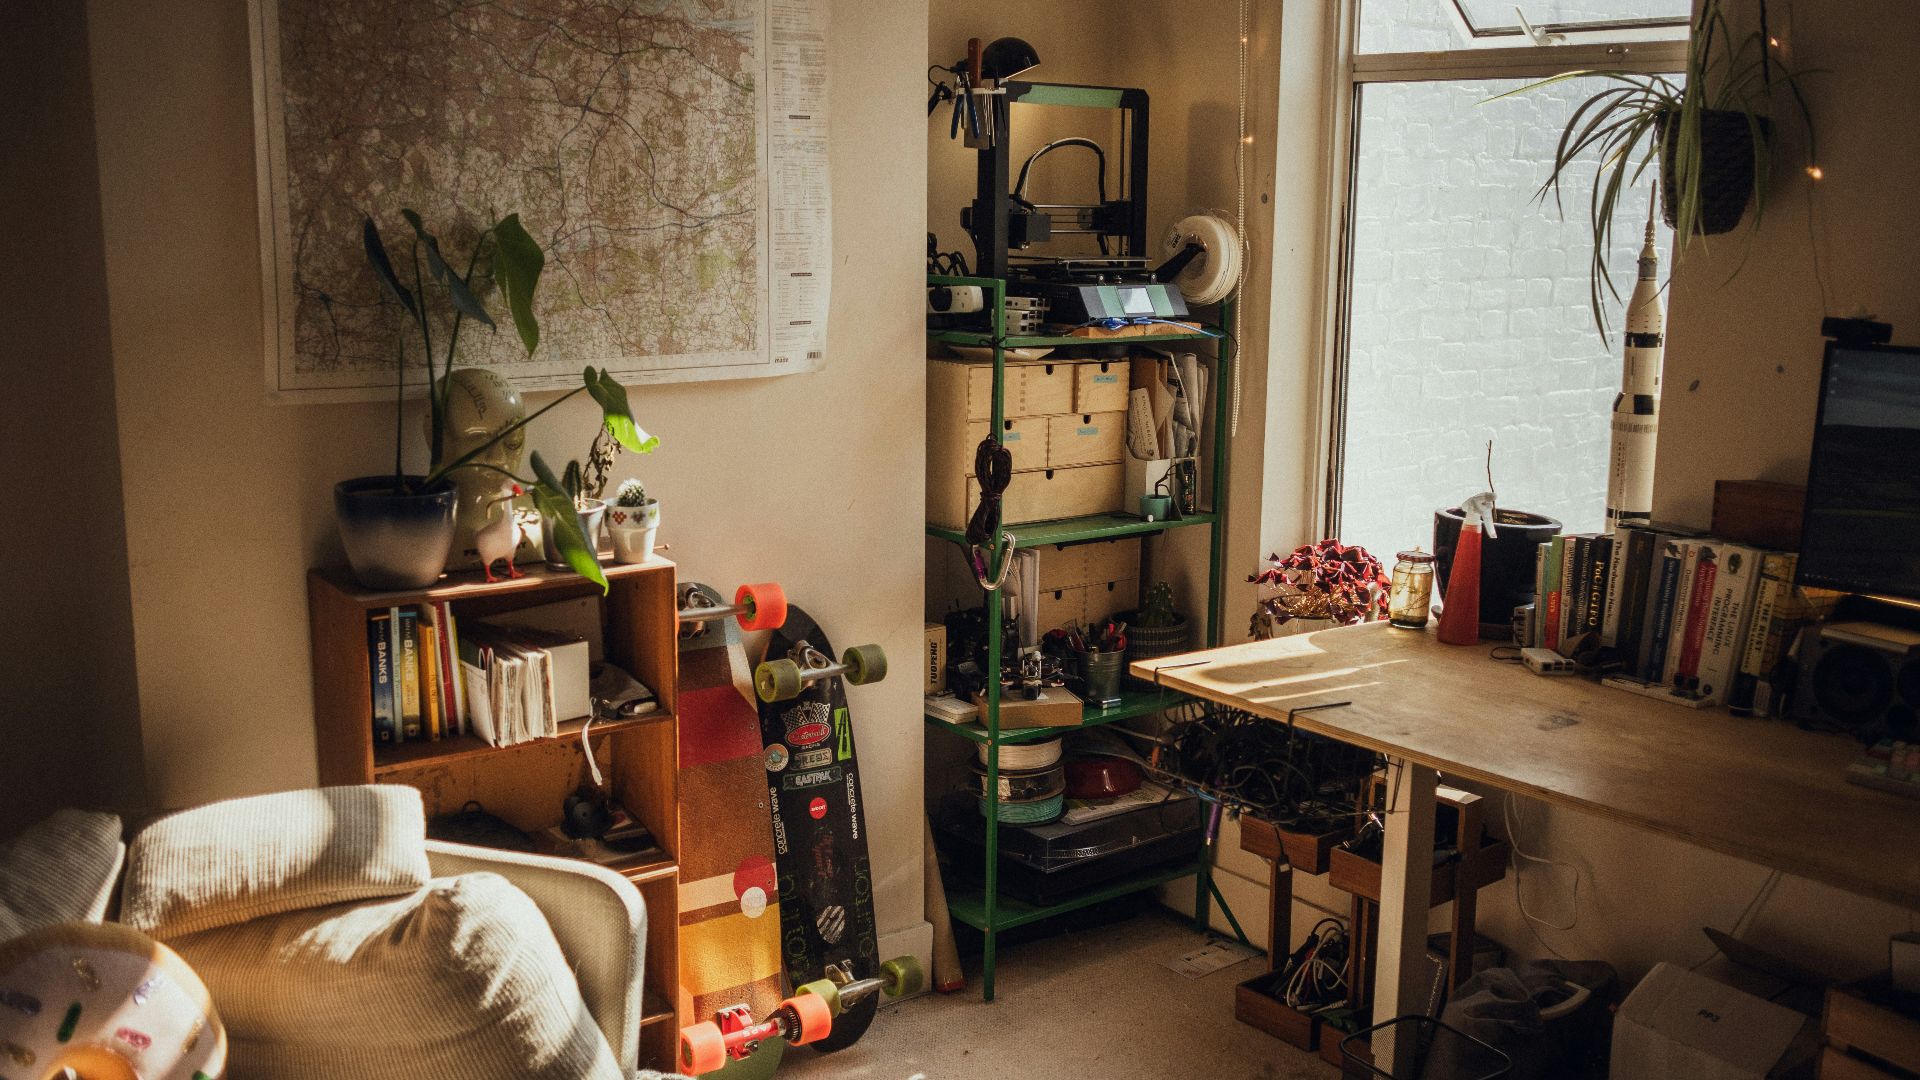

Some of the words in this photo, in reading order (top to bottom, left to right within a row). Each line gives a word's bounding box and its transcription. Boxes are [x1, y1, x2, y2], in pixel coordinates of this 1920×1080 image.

[1614, 540, 1622, 556] The
[1609, 557, 1621, 597] Hardware
[1706, 596, 1722, 644] INTERFACE
[1713, 588, 1733, 656] PROGRAMMING
[1729, 602, 1740, 619] THE
[1761, 603, 1771, 622] THE
[1723, 621, 1736, 648] LINUX
[1755, 624, 1767, 652] RUST
[377, 641, 388, 684] BANKS
[403, 639, 415, 682] BANKS
[930, 642, 938, 684] TUOPENG
[769, 786, 779, 813] wave
[848, 772, 857, 813] concrete
[772, 813, 785, 855] concrete
[851, 813, 859, 840] wave
